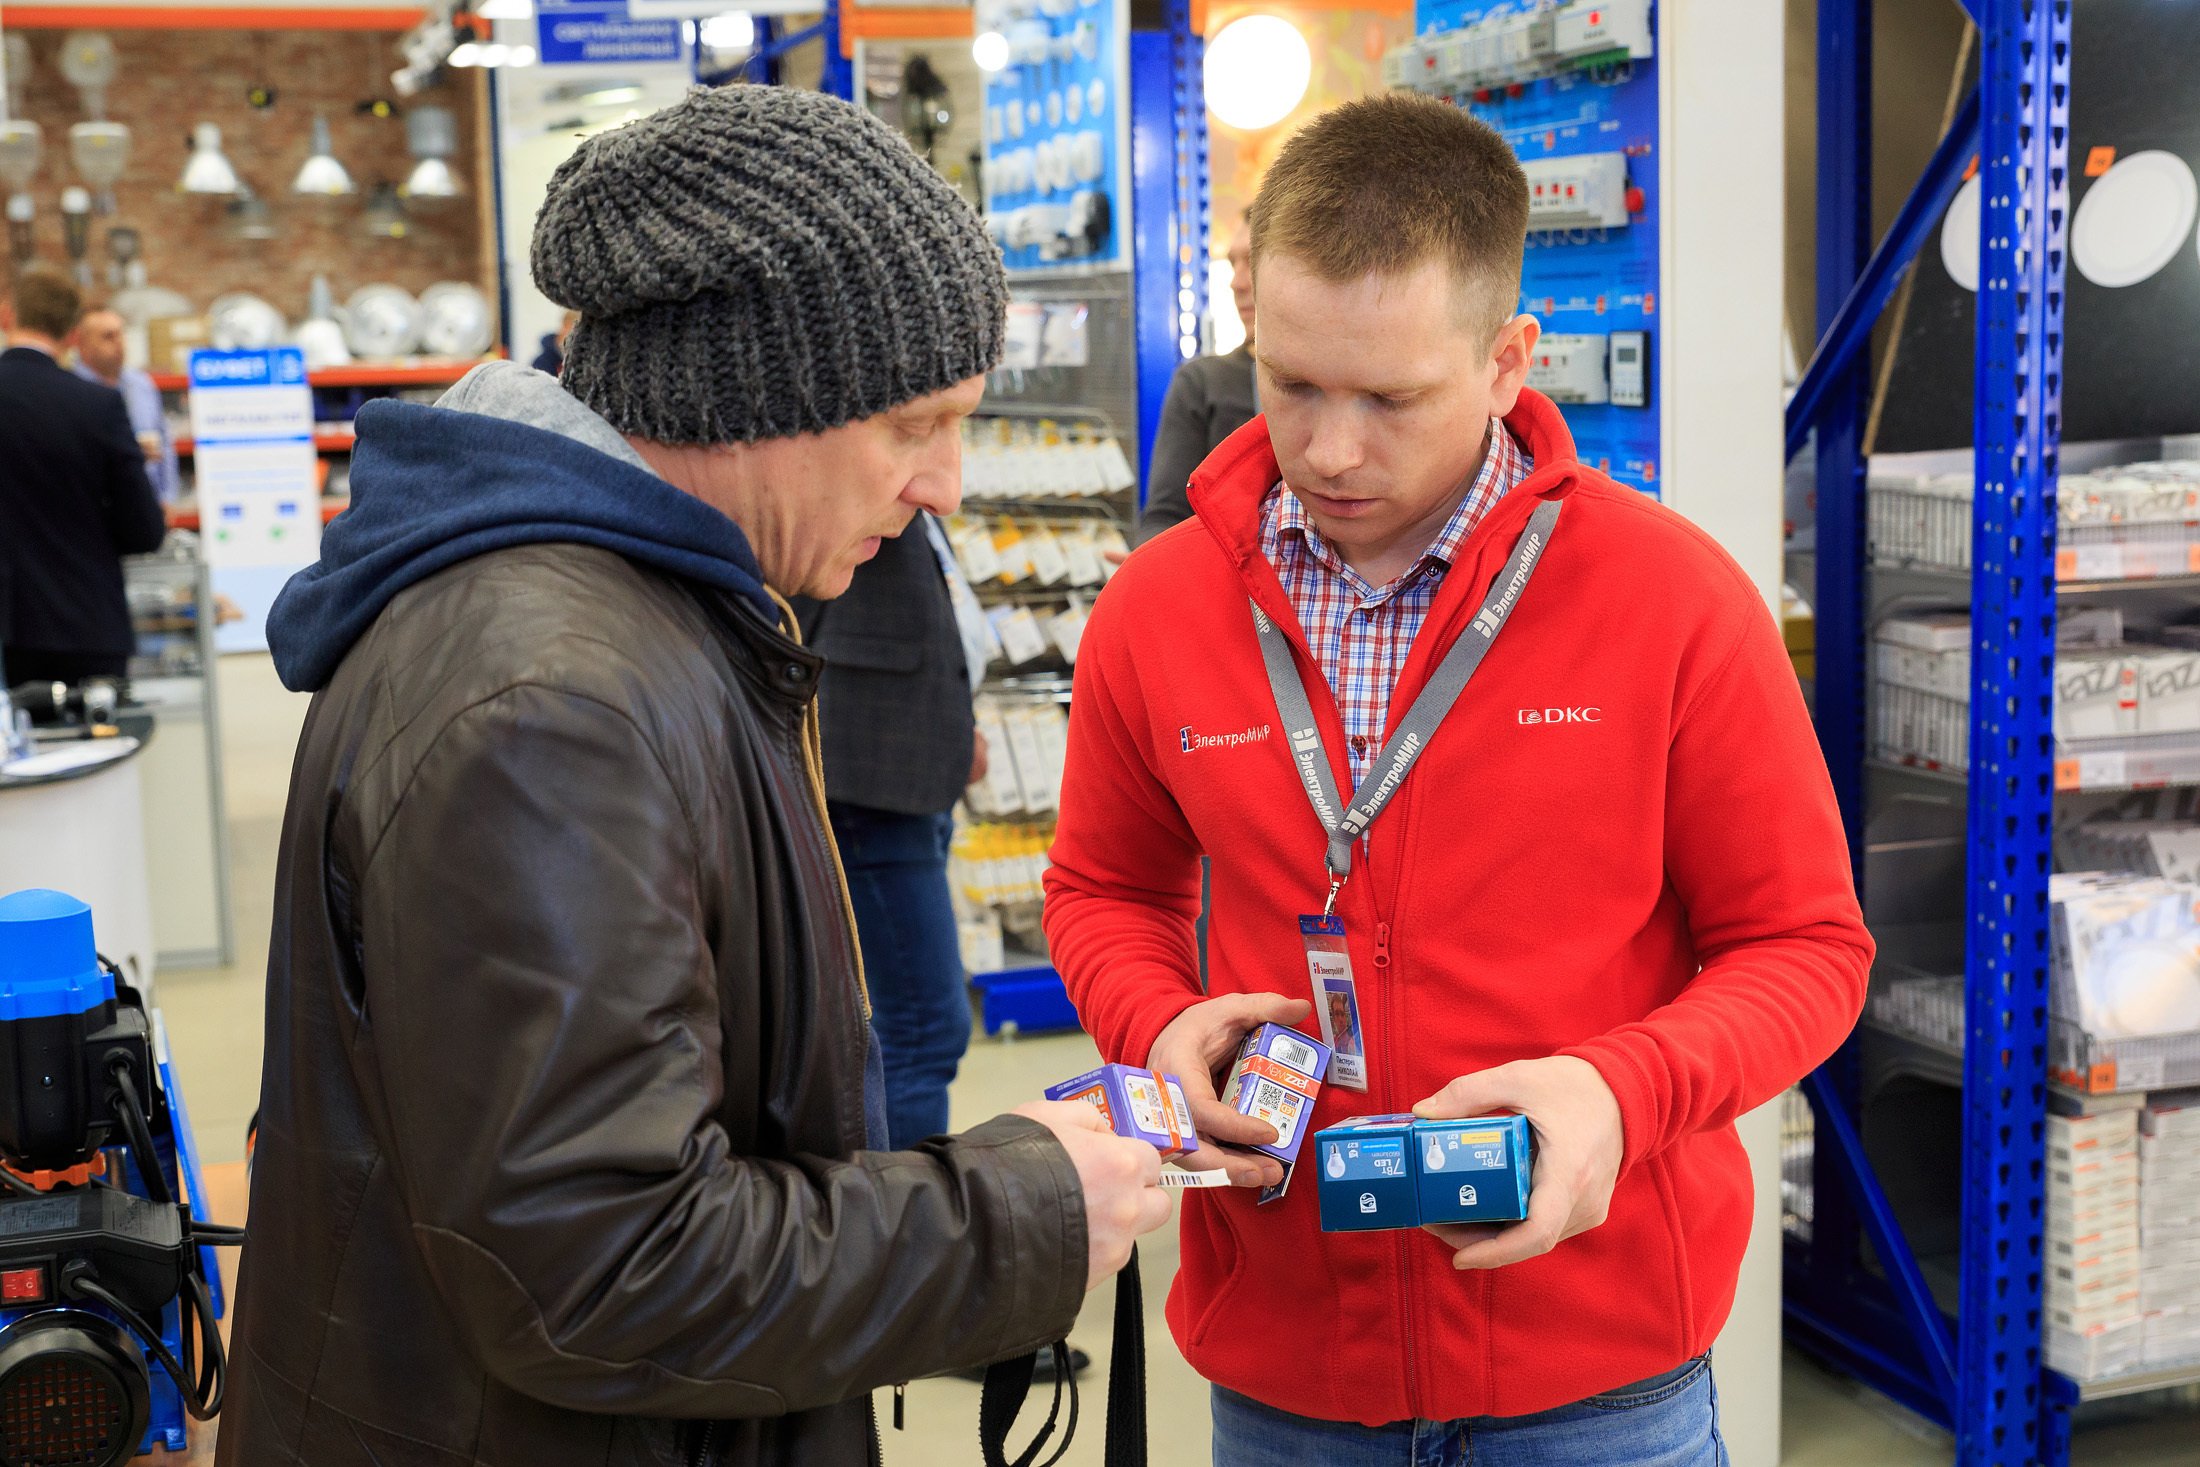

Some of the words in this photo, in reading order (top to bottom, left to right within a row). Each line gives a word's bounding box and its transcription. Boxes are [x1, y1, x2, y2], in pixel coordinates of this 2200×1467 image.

[1492, 532, 1542, 618] ЭлектроМИР
[1545, 706, 1602, 723] DKC
[1193, 724, 1271, 749] ЭлектроМИР
[1360, 732, 1421, 817] ЭлектроМИР
[1264, 1063, 1310, 1093] jazzway
[1280, 1102, 1296, 1117] LED
[1373, 1158, 1392, 1167] LED
[1474, 1150, 1492, 1159] LED
